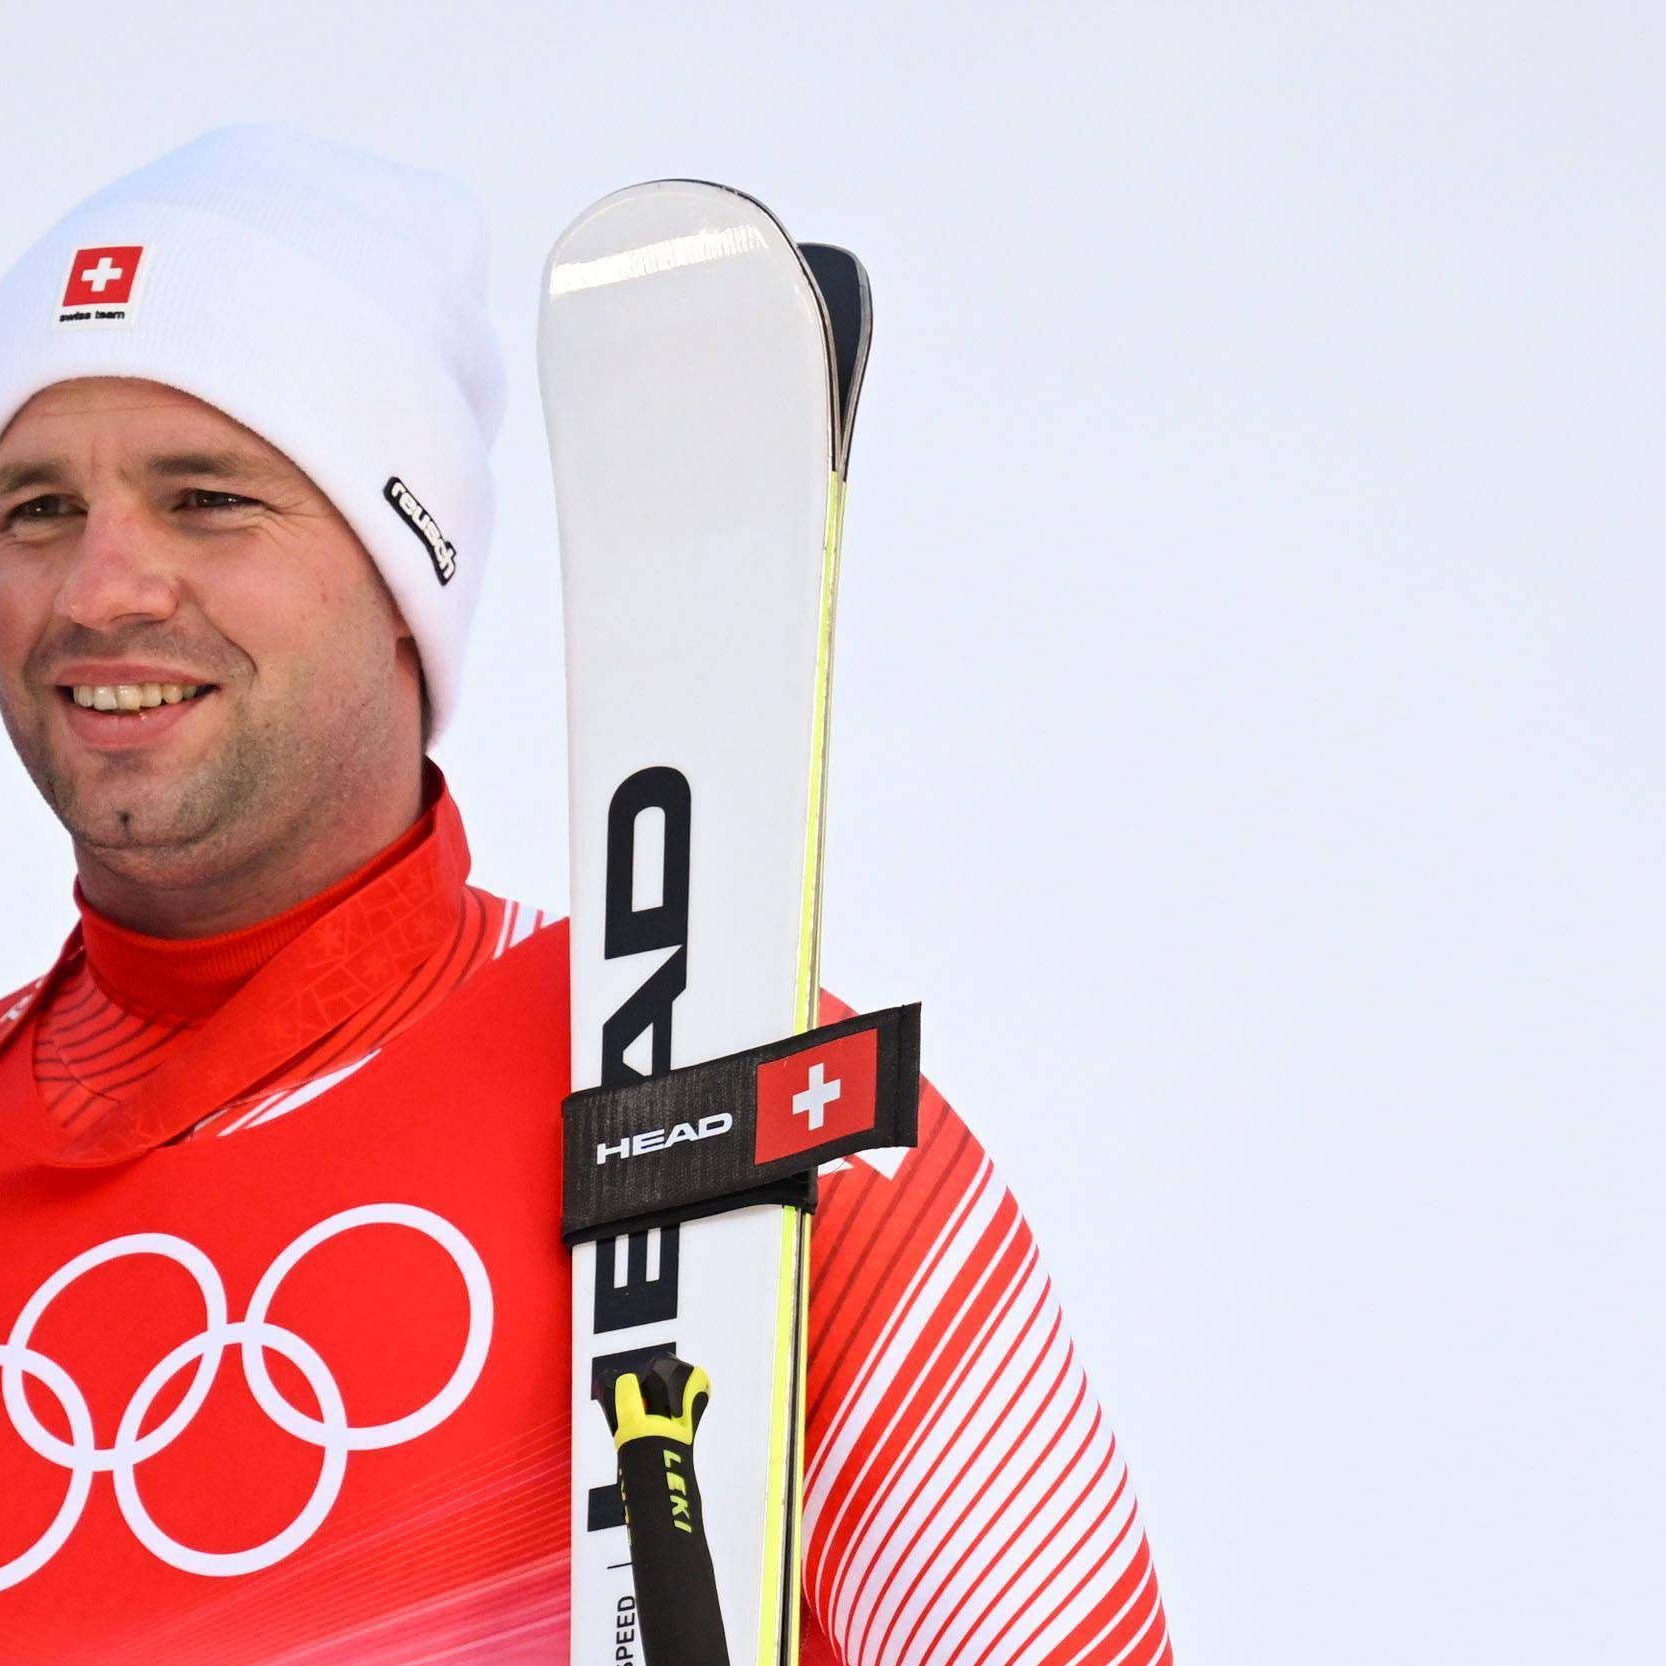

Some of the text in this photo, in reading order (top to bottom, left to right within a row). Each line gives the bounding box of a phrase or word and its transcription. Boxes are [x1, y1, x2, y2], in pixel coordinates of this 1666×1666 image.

[390, 481, 456, 580] reusch
[596, 1112, 733, 1165] HEAD
[663, 1449, 692, 1533] LEKI
